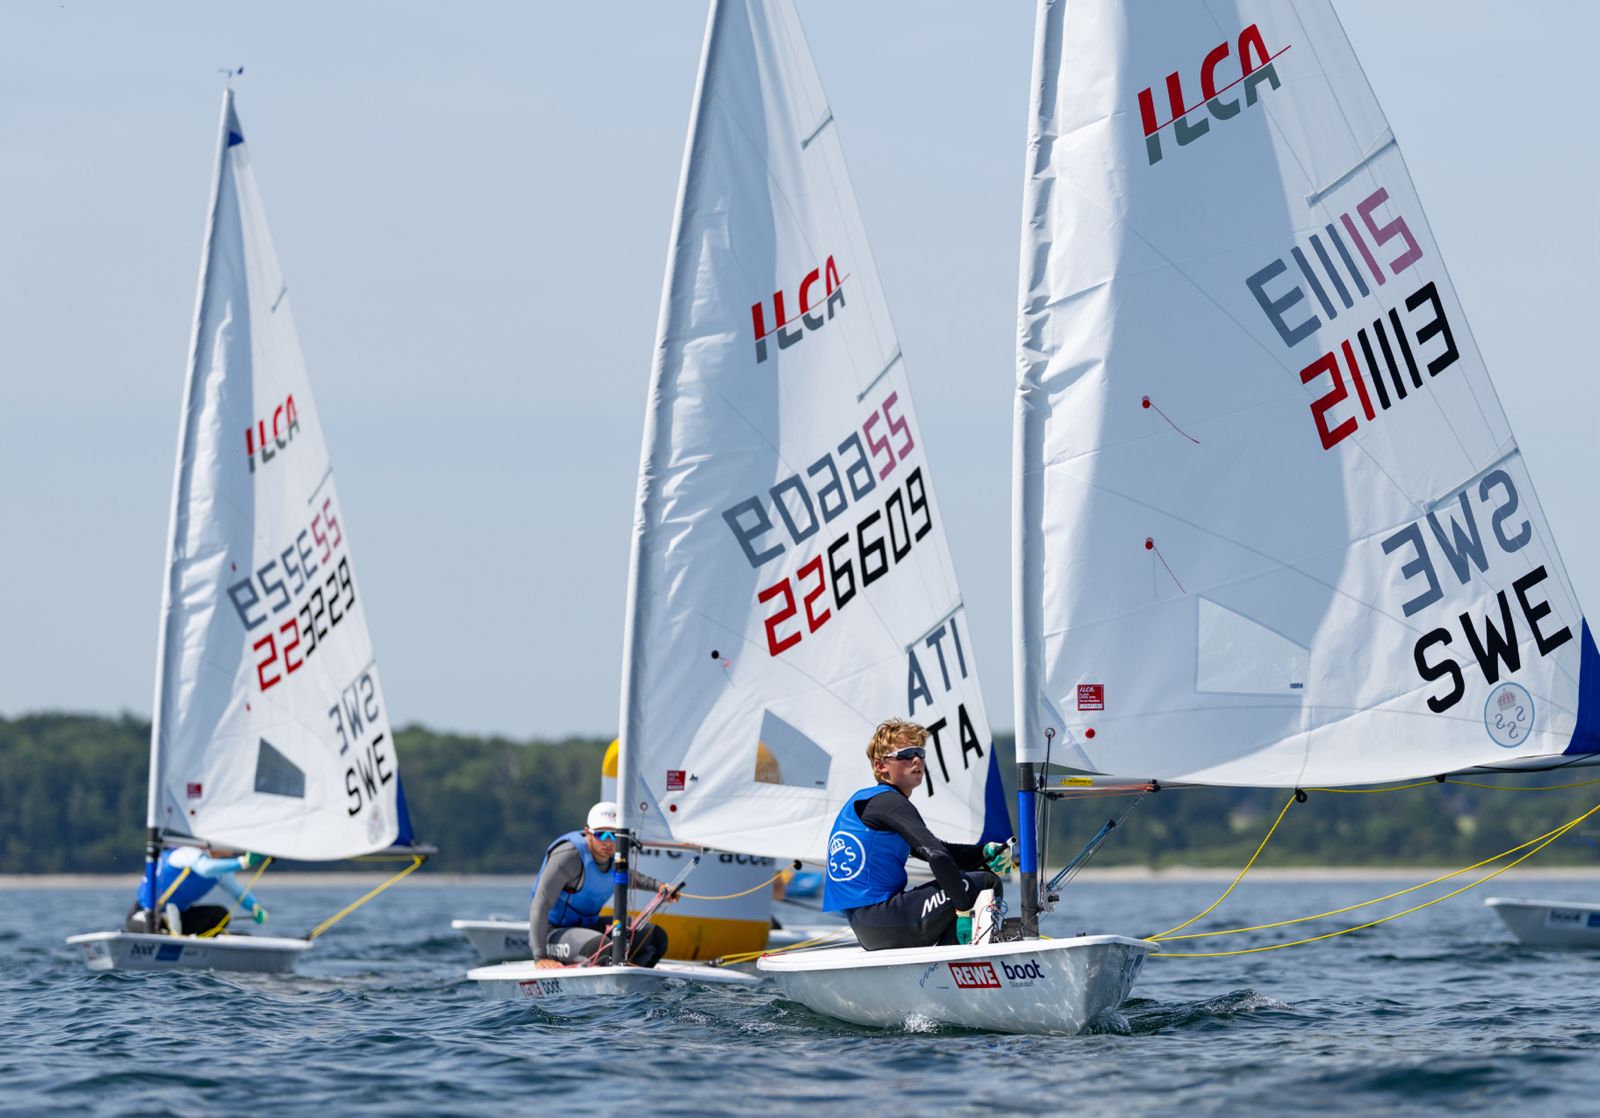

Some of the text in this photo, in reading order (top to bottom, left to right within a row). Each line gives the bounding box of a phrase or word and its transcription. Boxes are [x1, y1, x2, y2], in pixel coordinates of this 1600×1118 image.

[1137, 24, 1283, 167] ILCA
[751, 255, 847, 364] ILCA
[1300, 281, 1460, 451] 211113
[245, 393, 300, 474] ILCA
[252, 555, 355, 692] 223229
[758, 466, 932, 657] 226609
[1413, 565, 1573, 713] SWE
[345, 734, 392, 817] SWE
[952, 965, 995, 986] REWE
[1001, 959, 1045, 980] boot
